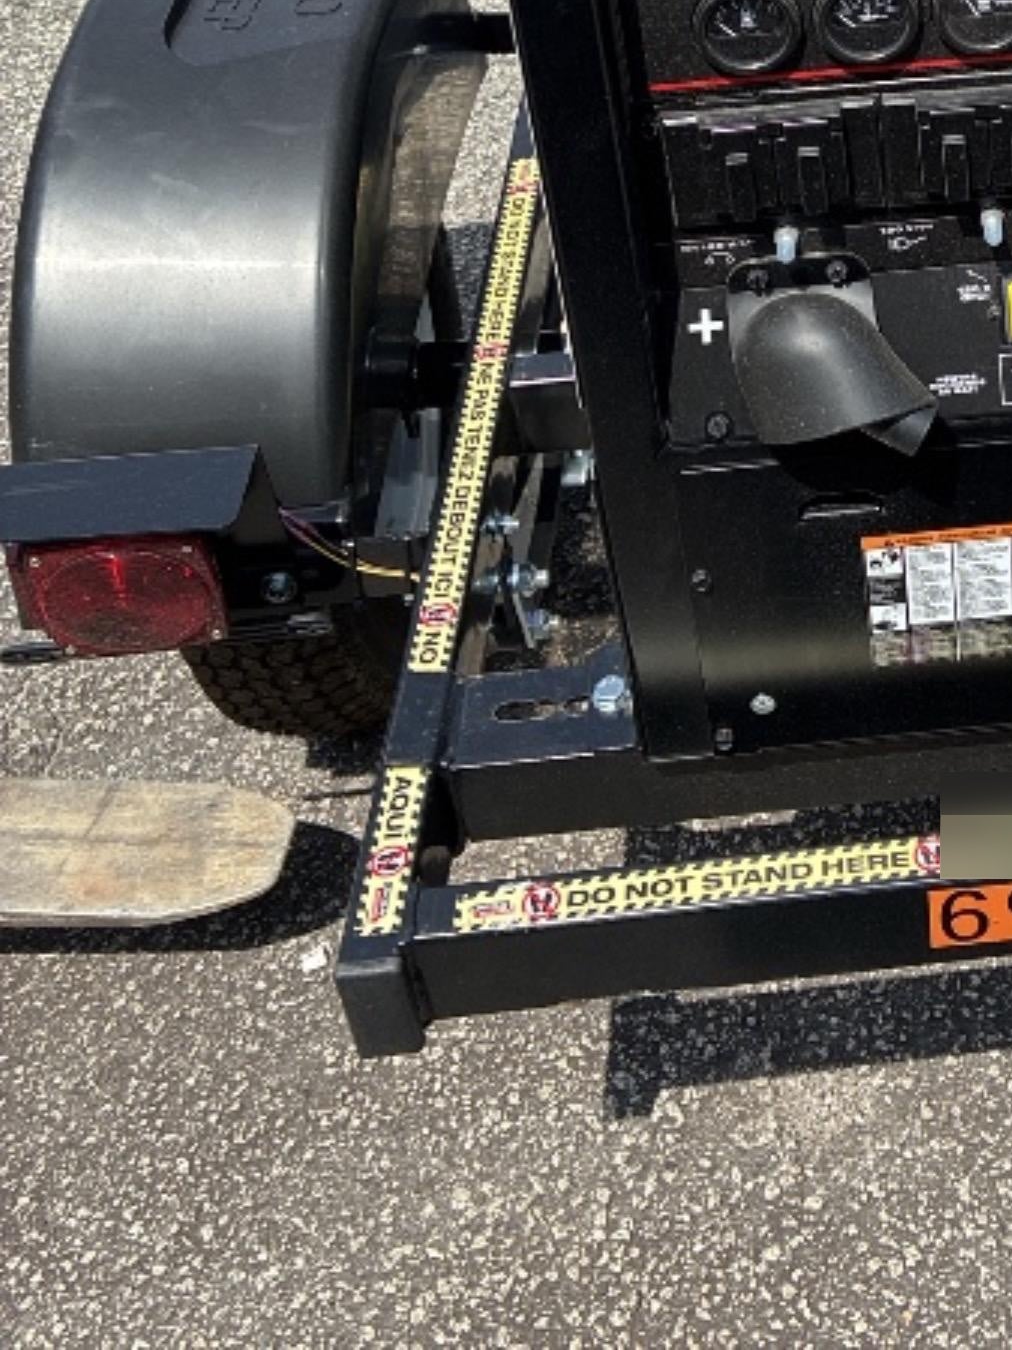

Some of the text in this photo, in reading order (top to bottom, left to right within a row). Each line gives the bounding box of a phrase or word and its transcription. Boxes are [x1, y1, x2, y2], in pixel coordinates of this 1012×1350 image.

[419, 362, 495, 664] NE PAS TENEZ DEBOUT ICI NO
[567, 851, 910, 907] DO NOT STAND HERE
